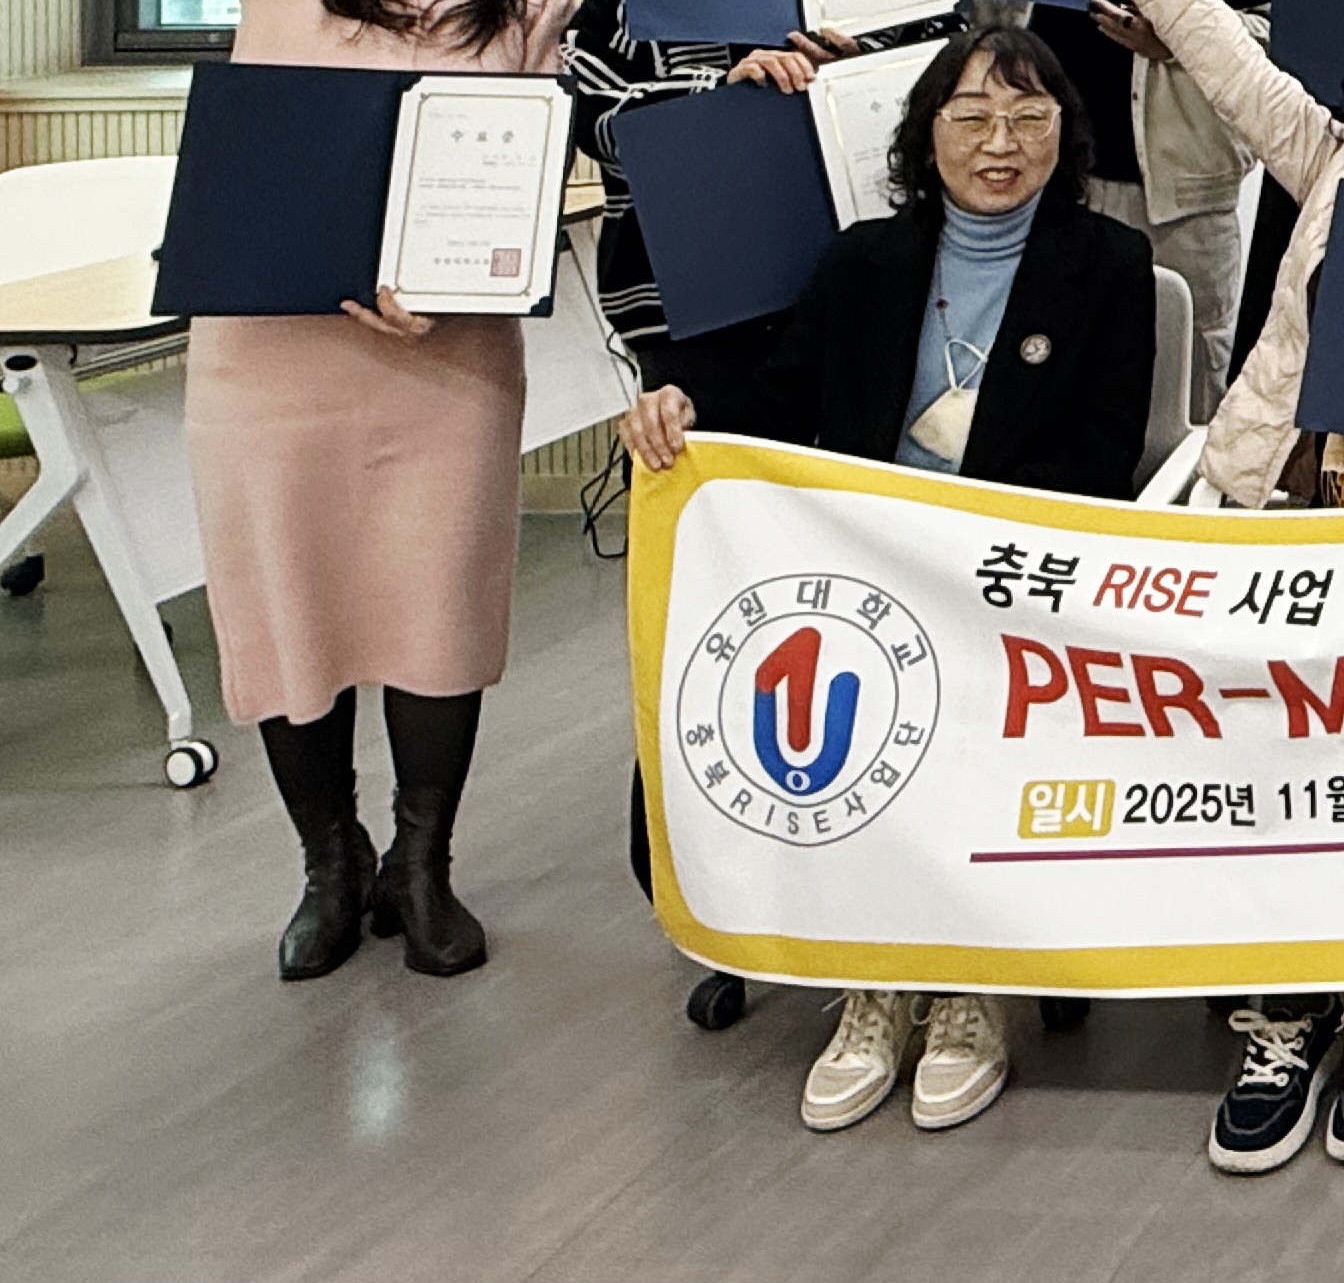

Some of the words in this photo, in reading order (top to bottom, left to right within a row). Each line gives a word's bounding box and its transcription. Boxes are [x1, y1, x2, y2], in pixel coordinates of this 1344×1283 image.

[705, 579, 928, 672] 유원대학교
[974, 542, 1081, 614] 충북
[1092, 562, 1218, 619] RISE
[1228, 568, 1336, 629] 사업
[1027, 782, 1107, 834] 일시
[1123, 780, 1257, 828] 2025년
